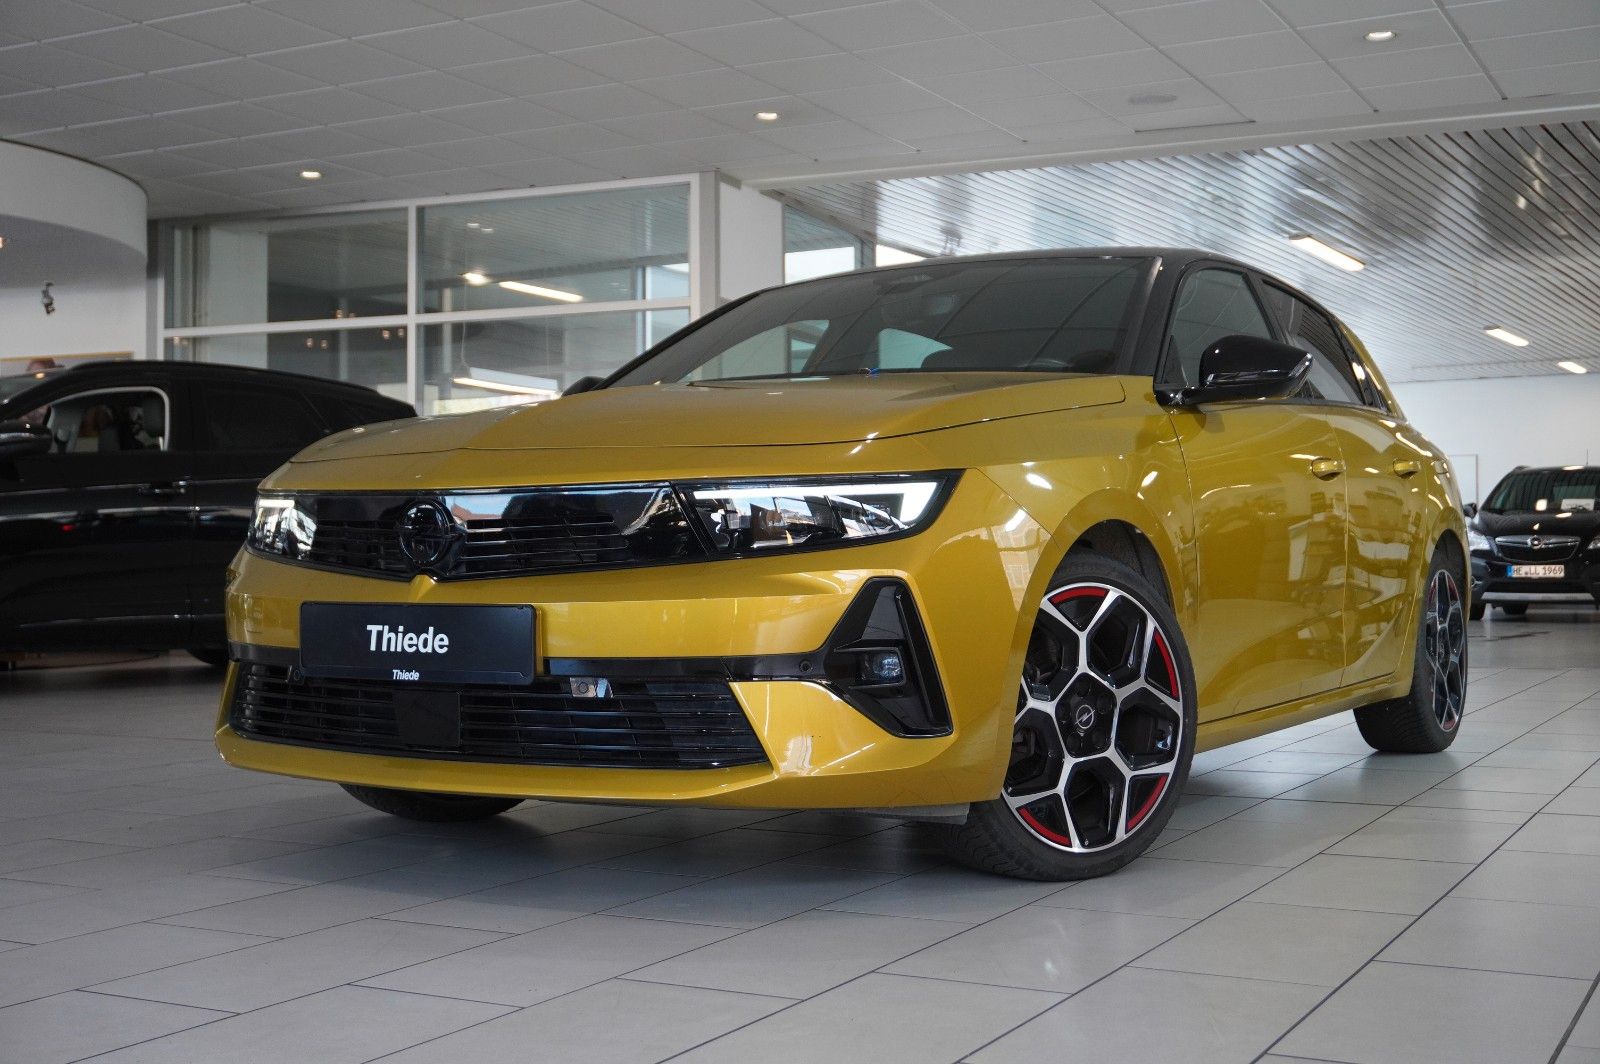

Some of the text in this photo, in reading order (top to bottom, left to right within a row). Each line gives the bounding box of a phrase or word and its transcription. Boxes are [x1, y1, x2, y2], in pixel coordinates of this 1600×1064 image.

[1543, 565, 1563, 576] 1969
[366, 624, 449, 654] Thiede
[392, 669, 420, 680] Thiede
